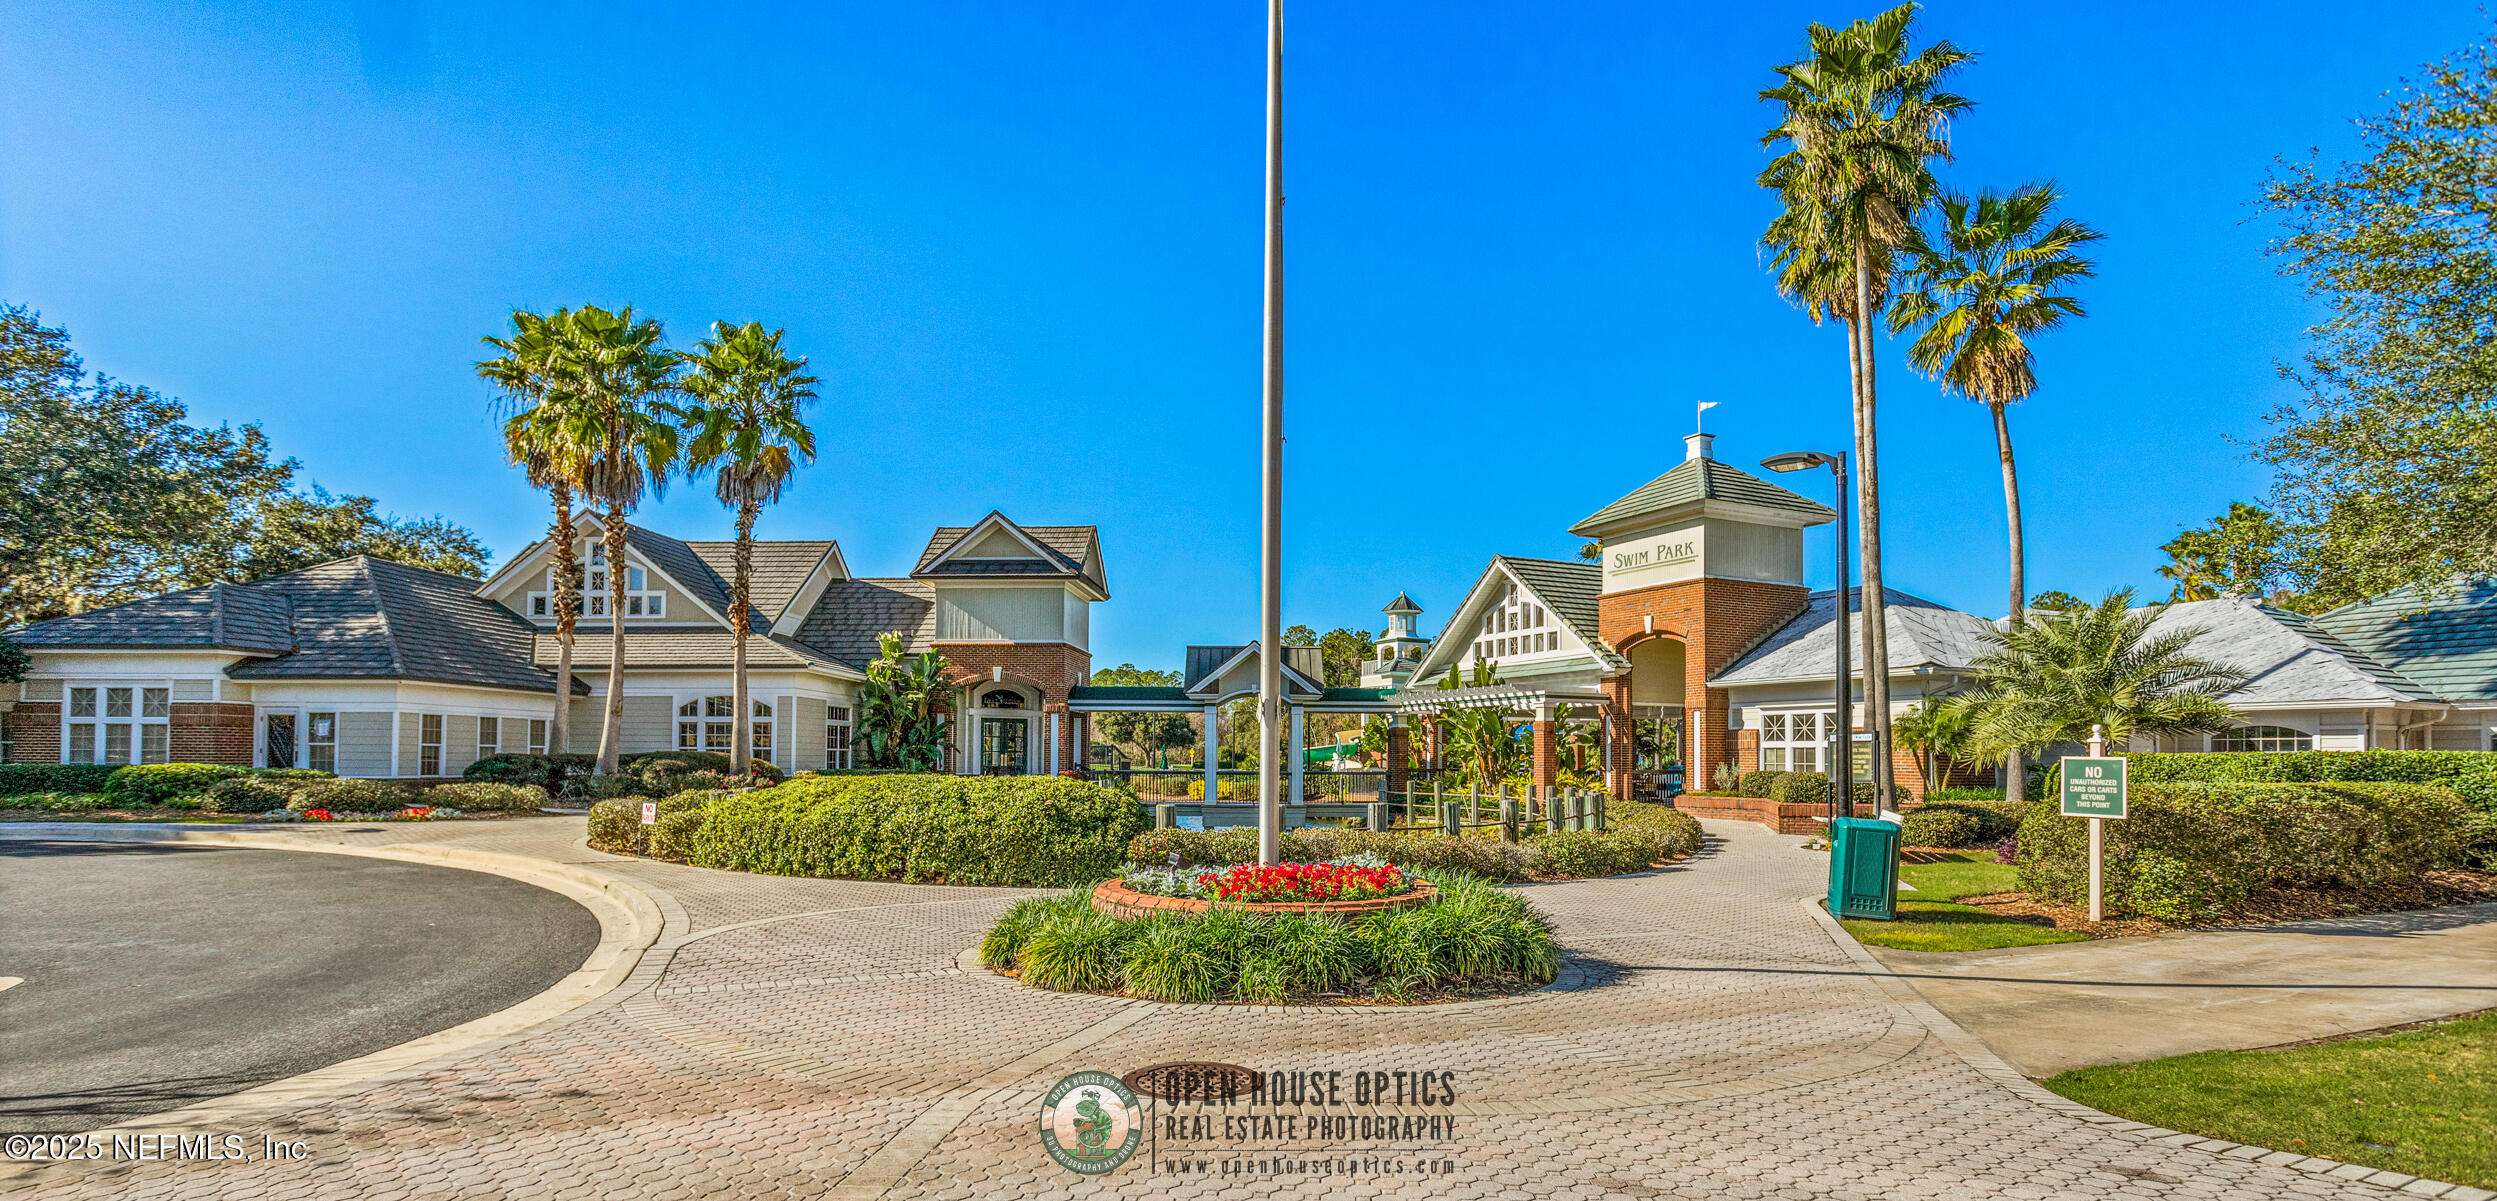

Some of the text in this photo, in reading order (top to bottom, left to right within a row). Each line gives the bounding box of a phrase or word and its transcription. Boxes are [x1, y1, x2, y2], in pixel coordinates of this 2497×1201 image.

[1613, 541, 1694, 568] SWIM PARK
[2085, 766, 2102, 778] NO
[2070, 778, 2117, 786] UNAUTHORIZED
[2097, 786, 2118, 794] CARTS
[2081, 793, 2106, 801] BEYOND
[645, 804, 653, 813] NO
[2091, 801, 2111, 809] POINT
